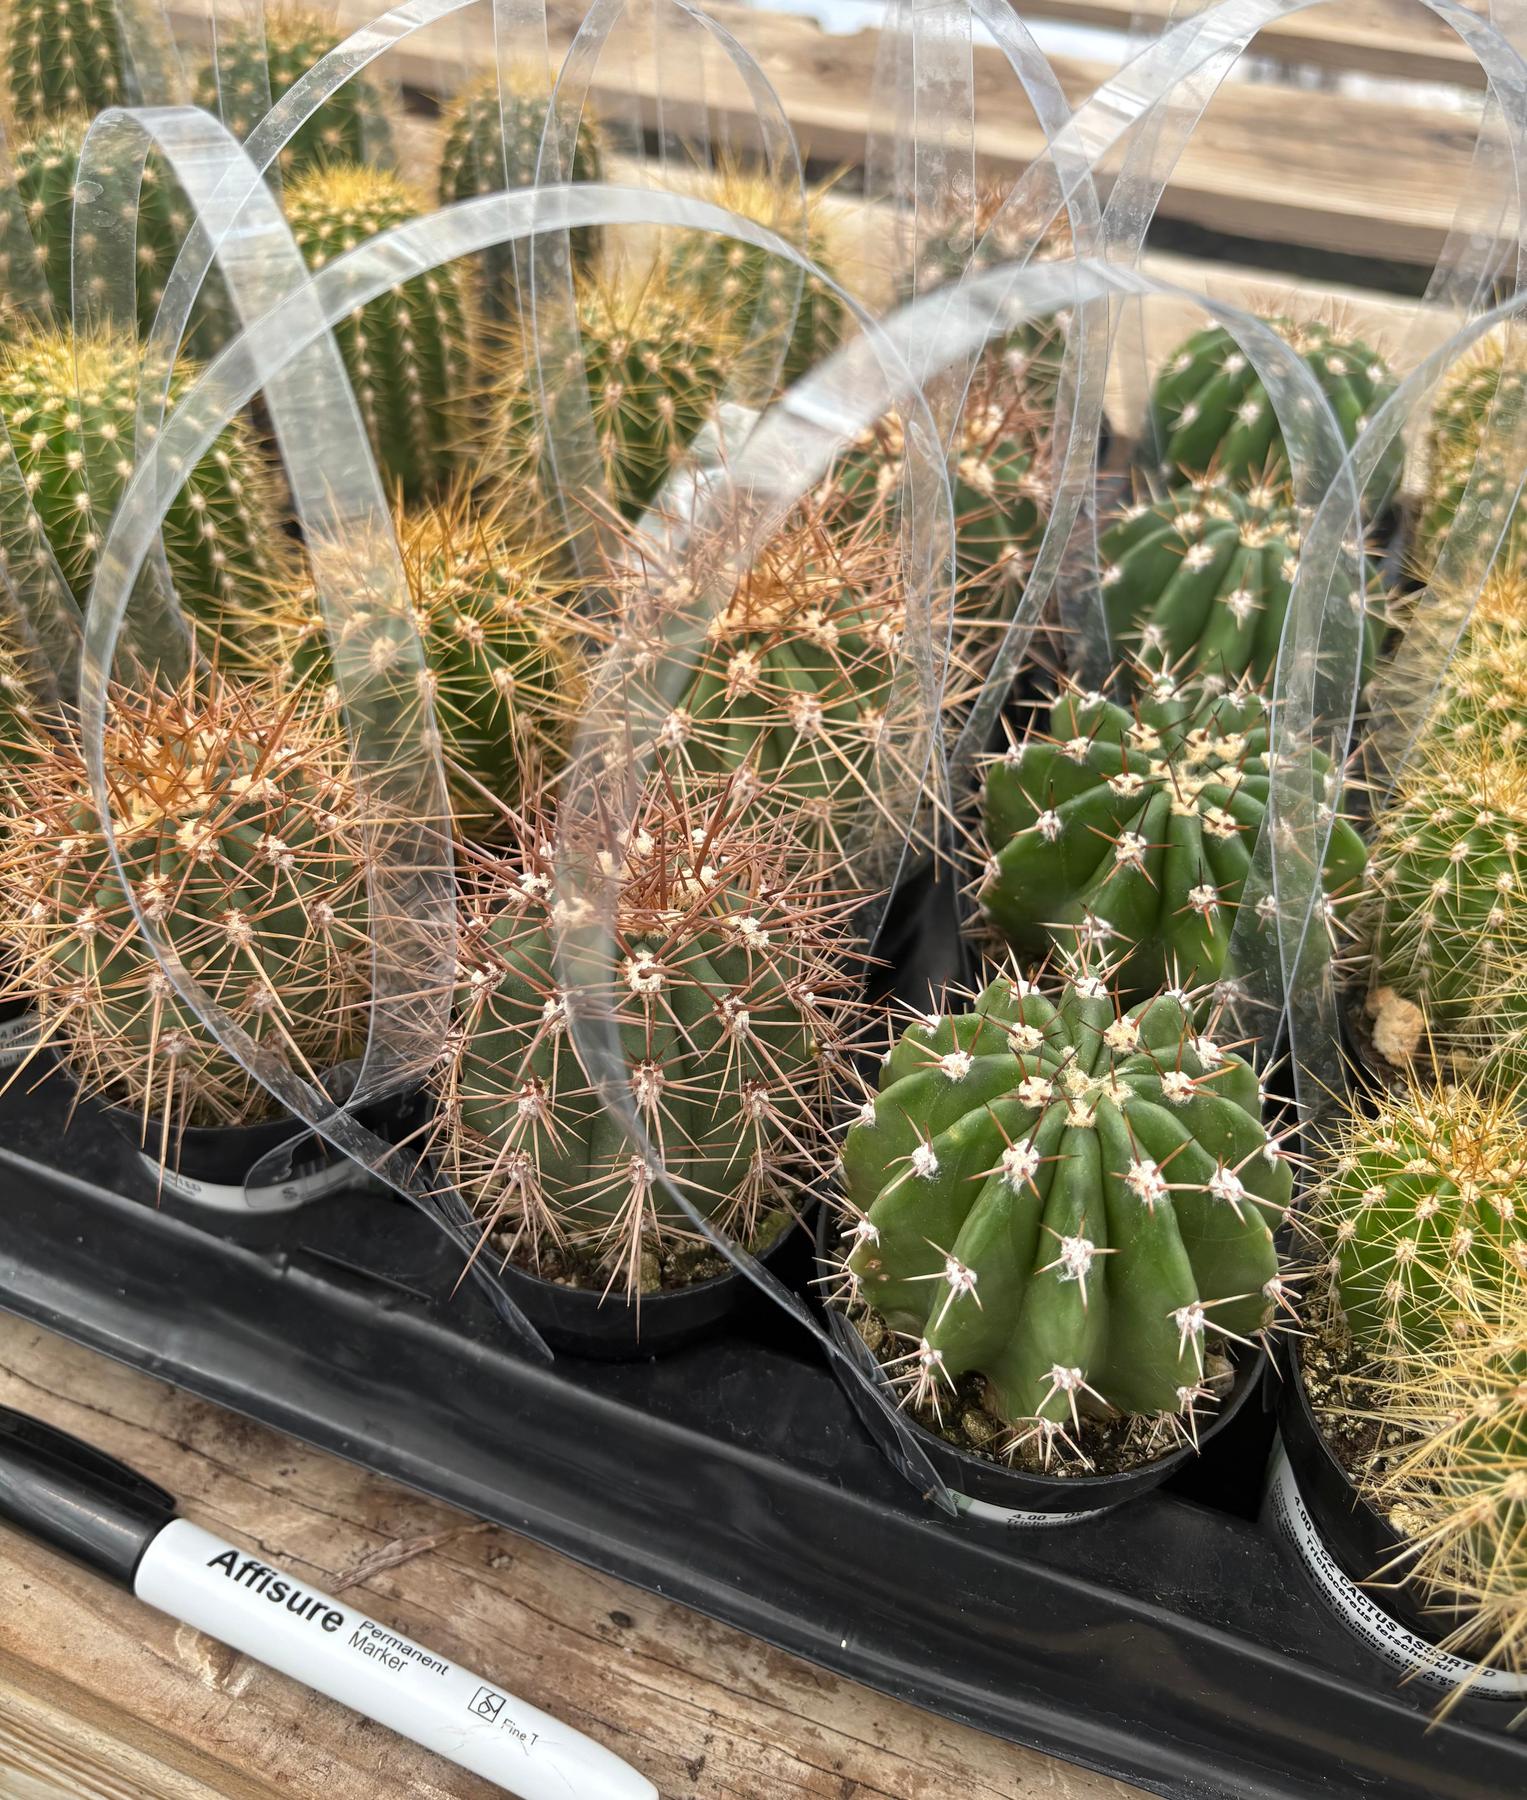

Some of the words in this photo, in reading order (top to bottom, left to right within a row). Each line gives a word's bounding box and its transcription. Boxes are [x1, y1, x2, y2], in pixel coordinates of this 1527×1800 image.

[206, 1550, 345, 1633] Affisure
[1294, 1496, 1311, 1532] 4.00
[1339, 1575, 1398, 1633] CACTUS
[1400, 1634, 1497, 1677] ASSORTED
[1306, 1535, 1372, 1623] Trichocereus
[348, 1631, 409, 1672] Marker
[359, 1620, 451, 1676] Permanent
[1354, 1620, 1386, 1649] native
[1389, 1649, 1401, 1659] to
[501, 1718, 527, 1741] Fine
